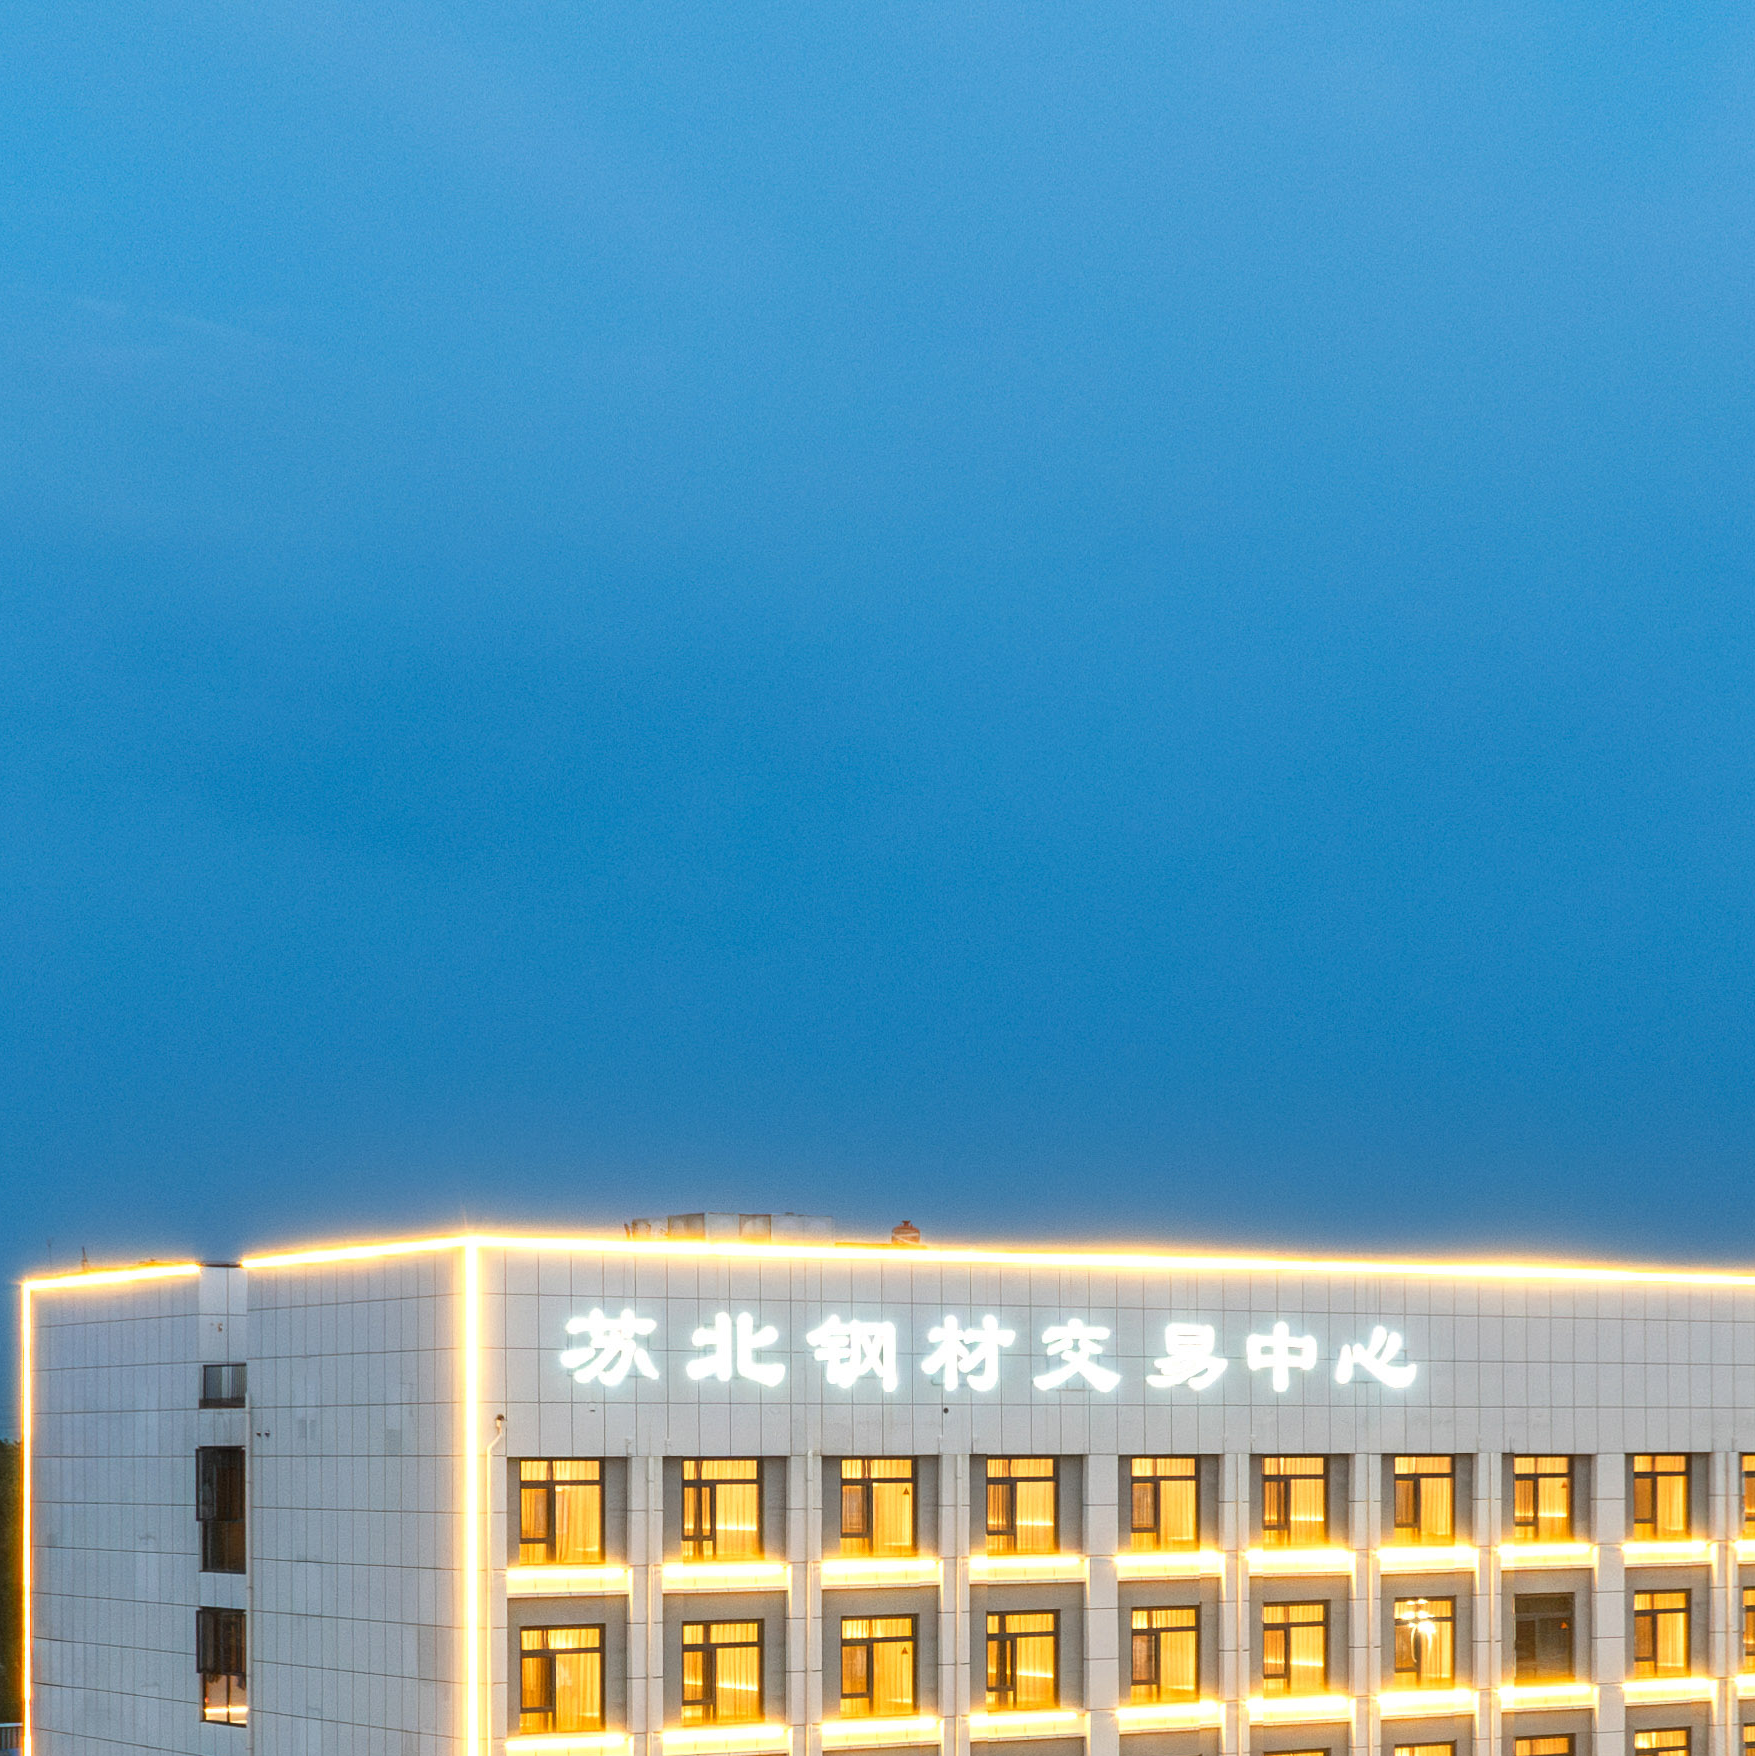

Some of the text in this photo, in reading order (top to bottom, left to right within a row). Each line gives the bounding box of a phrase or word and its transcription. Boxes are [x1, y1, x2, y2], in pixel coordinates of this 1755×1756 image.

[560, 1307, 1418, 1393] 苏北钢材交易中心
